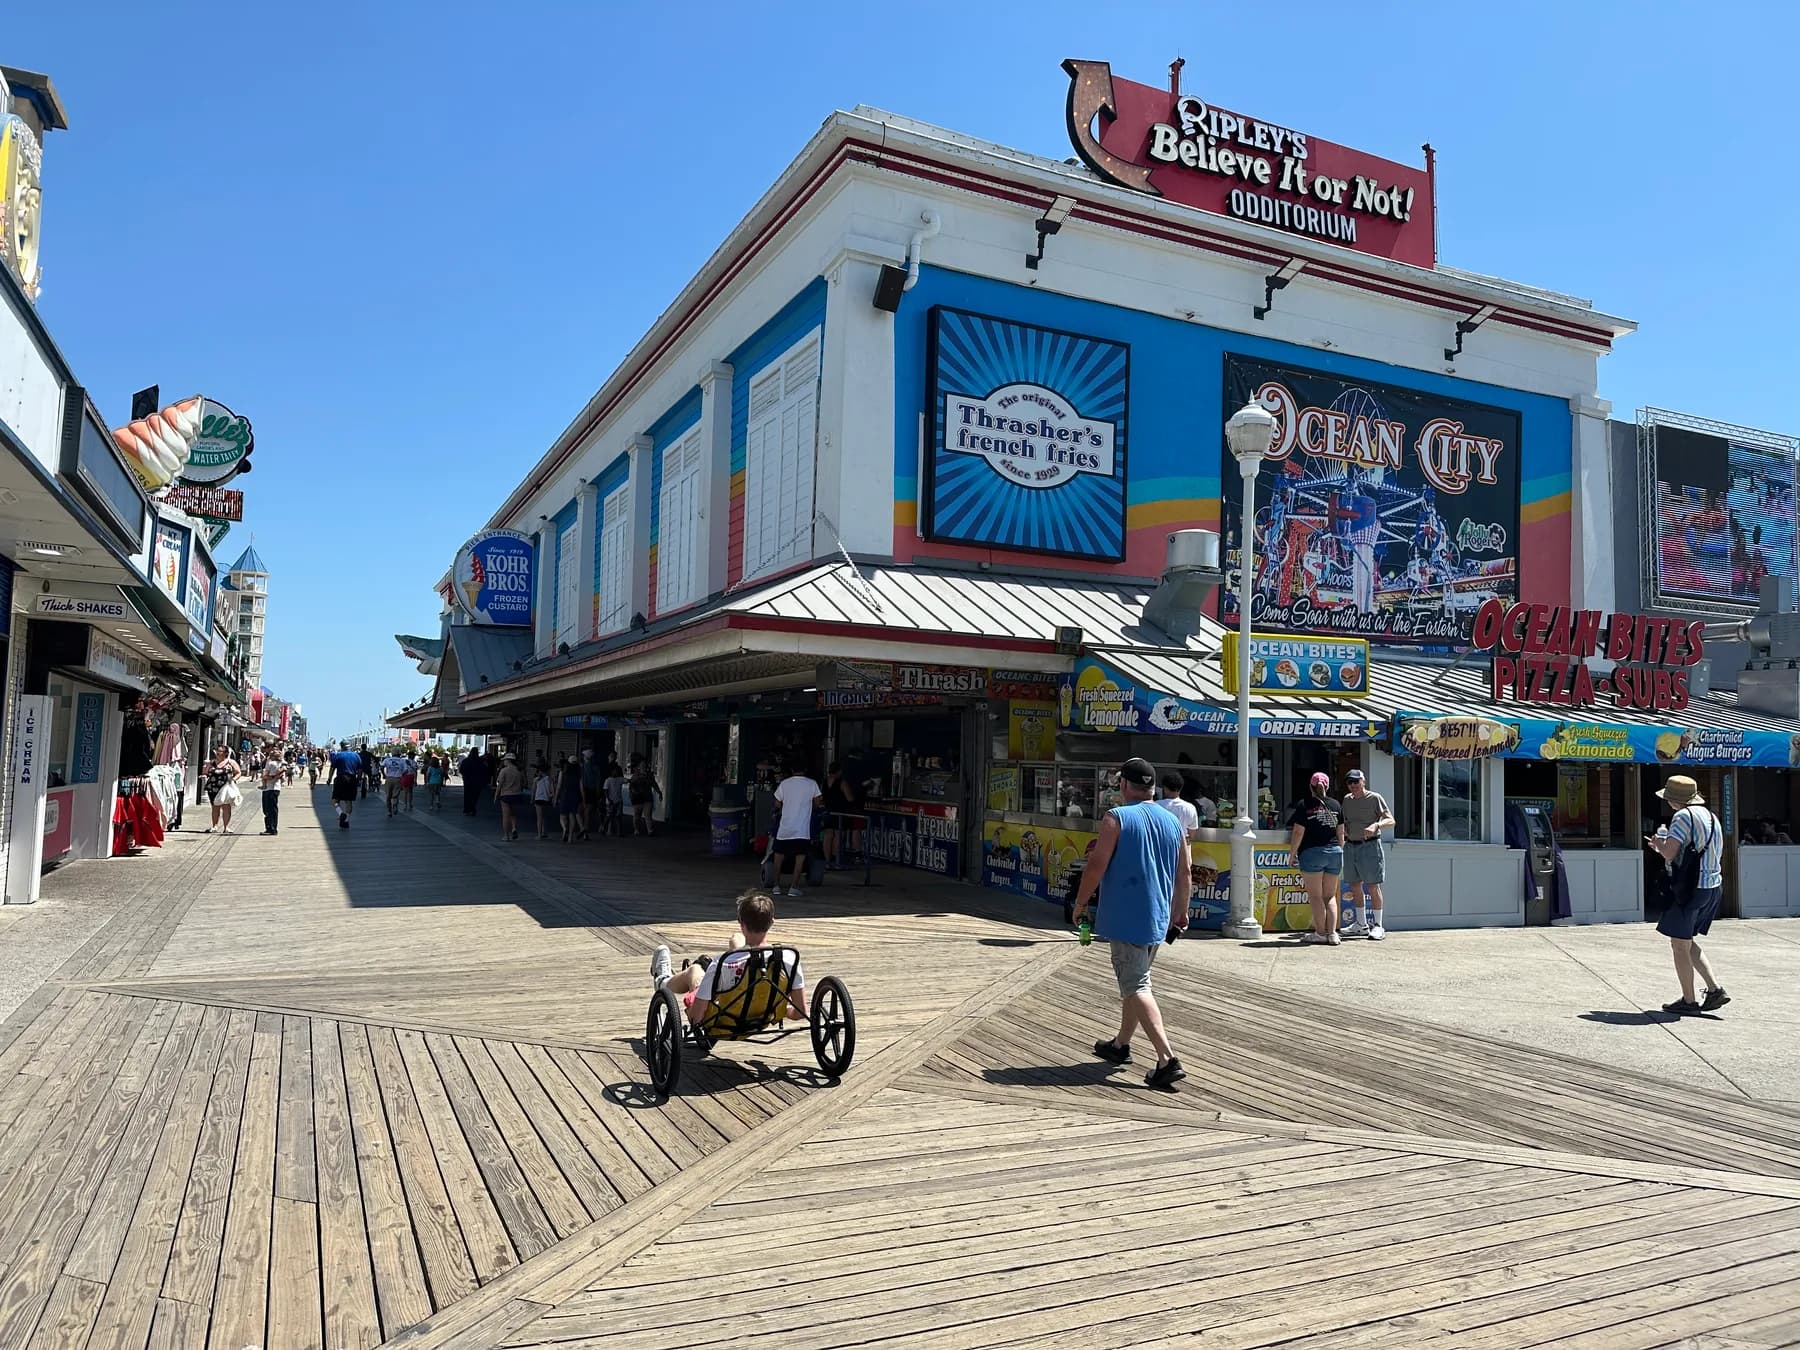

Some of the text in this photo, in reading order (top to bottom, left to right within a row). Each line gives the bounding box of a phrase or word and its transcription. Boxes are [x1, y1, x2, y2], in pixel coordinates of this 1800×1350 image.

[1177, 95, 1309, 160] RIPLEY'S
[1150, 123, 1416, 223] Believe It or Not!
[1230, 189, 1357, 243] ODDITORIUM
[998, 393, 1067, 420] The original
[200, 414, 250, 446] lle's
[957, 404, 1103, 446] Thrasher's
[1257, 382, 1503, 494] OCEAN CITY
[194, 449, 239, 464] WATER TAFFY
[958, 429, 1100, 469] french fries
[1000, 458, 1061, 481] since 1929
[483, 530, 522, 540] ENTRANCE
[1465, 535, 1491, 549] Roger
[486, 554, 529, 574] KOHR
[41, 599, 123, 616] Thick SHAKES
[487, 602, 529, 612] CUSTARD
[494, 594, 529, 604] FROZEN
[1250, 593, 1289, 623] Come
[1291, 594, 1330, 626] Soar
[1331, 607, 1358, 627] with
[1358, 616, 1372, 631] us
[1374, 613, 1389, 632] at
[1392, 615, 1411, 634] the
[1411, 612, 1460, 638] Eastern
[1472, 598, 1707, 667] OCEAN BITES
[1250, 641, 1356, 660] OCEAN BITES
[900, 665, 988, 691] Thrash
[1494, 657, 1690, 710] PIZZA SUBS
[1079, 686, 1135, 704] Fresh Squeezed
[26, 708, 35, 735] ICE
[1084, 704, 1139, 727] Lemonade
[1189, 711, 1226, 722] OCEAN
[1208, 722, 1239, 733] BITES
[1259, 720, 1361, 737] ORDER HERE
[1569, 724, 1591, 740] Fresh
[1699, 730, 1744, 744] Charbroiled
[1427, 740, 1472, 759] Squeezed
[1472, 735, 1517, 758] Lemonade
[1559, 742, 1634, 759] Lemonade
[1686, 743, 1752, 761] Angus Burgers
[20, 738, 33, 784] CREAM
[917, 806, 960, 842] french
[915, 837, 948, 870] fries
[1257, 853, 1290, 867] OCEAN
[1019, 861, 1041, 876] Chicken
[1022, 878, 1037, 894] Wrap
[1271, 873, 1294, 887] Fresh
[1191, 883, 1230, 901] Pulled
[1278, 887, 1311, 905] Lemo
[1188, 905, 1209, 920] ork
